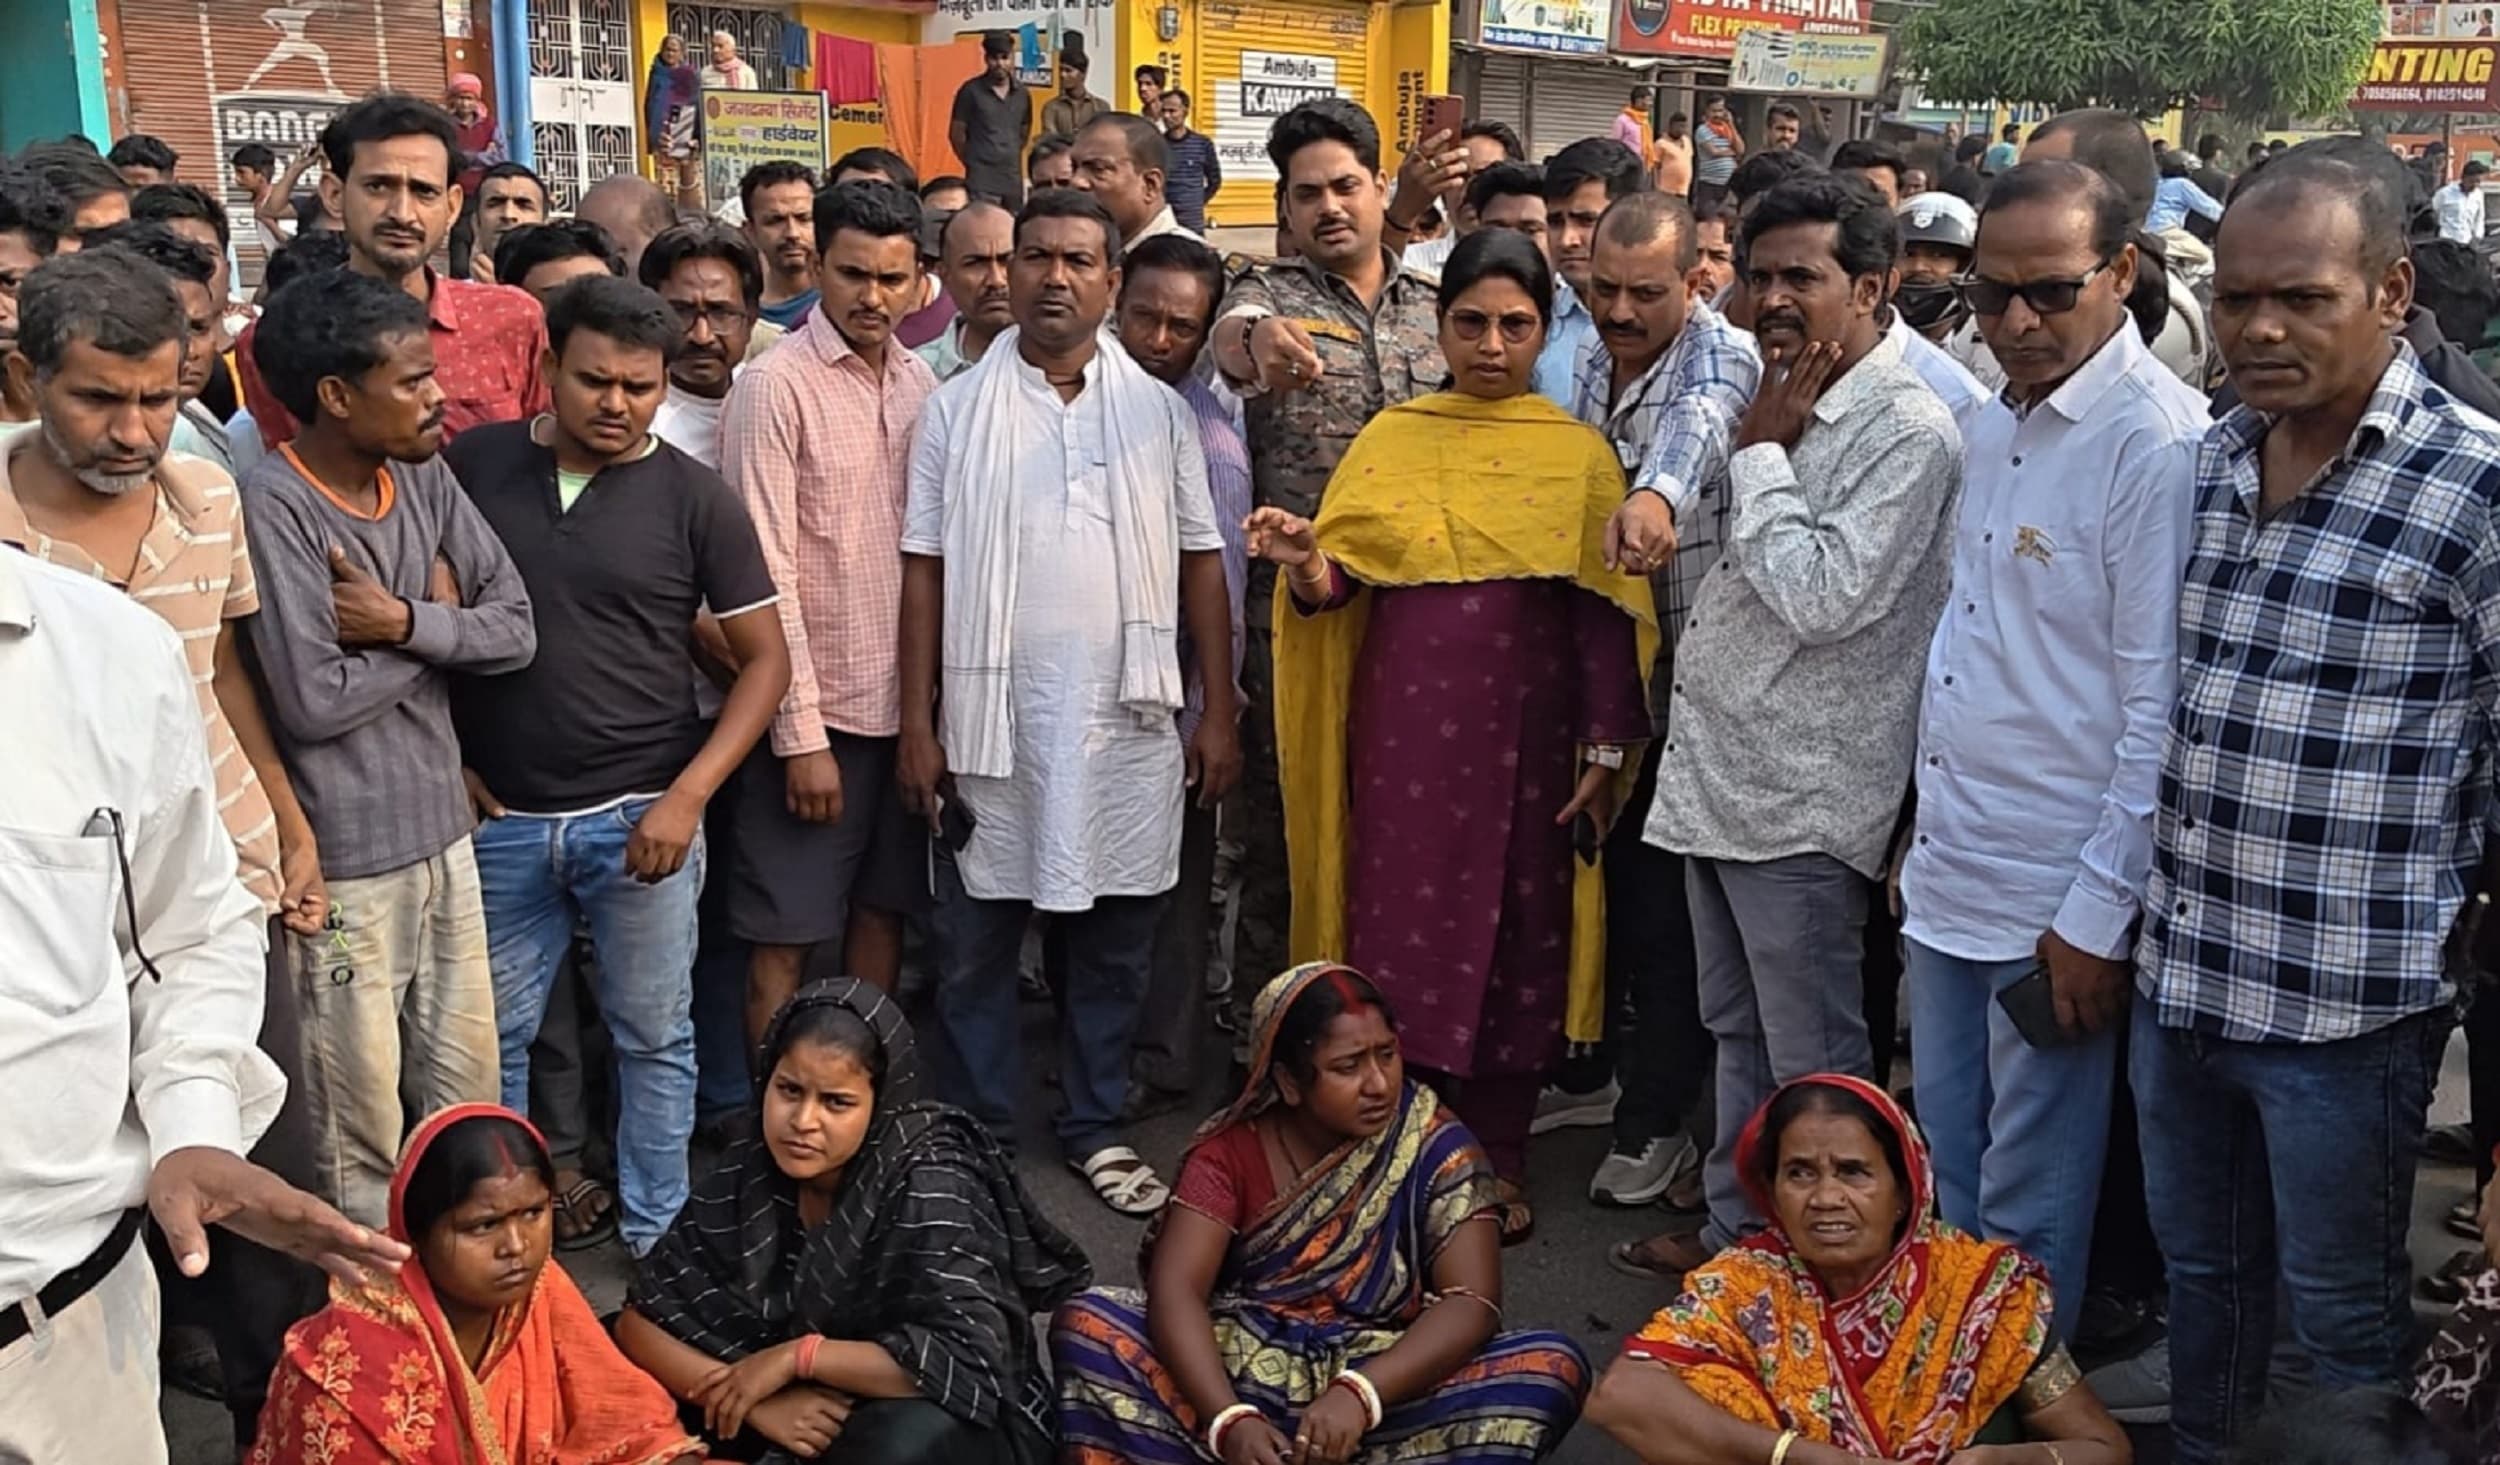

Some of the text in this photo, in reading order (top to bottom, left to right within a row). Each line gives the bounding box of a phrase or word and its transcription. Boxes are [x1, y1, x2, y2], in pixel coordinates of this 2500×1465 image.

[1689, 13, 1722, 35] FLEX
[1263, 57, 1318, 80] Ambuja
[2367, 46, 2495, 84] NTING
